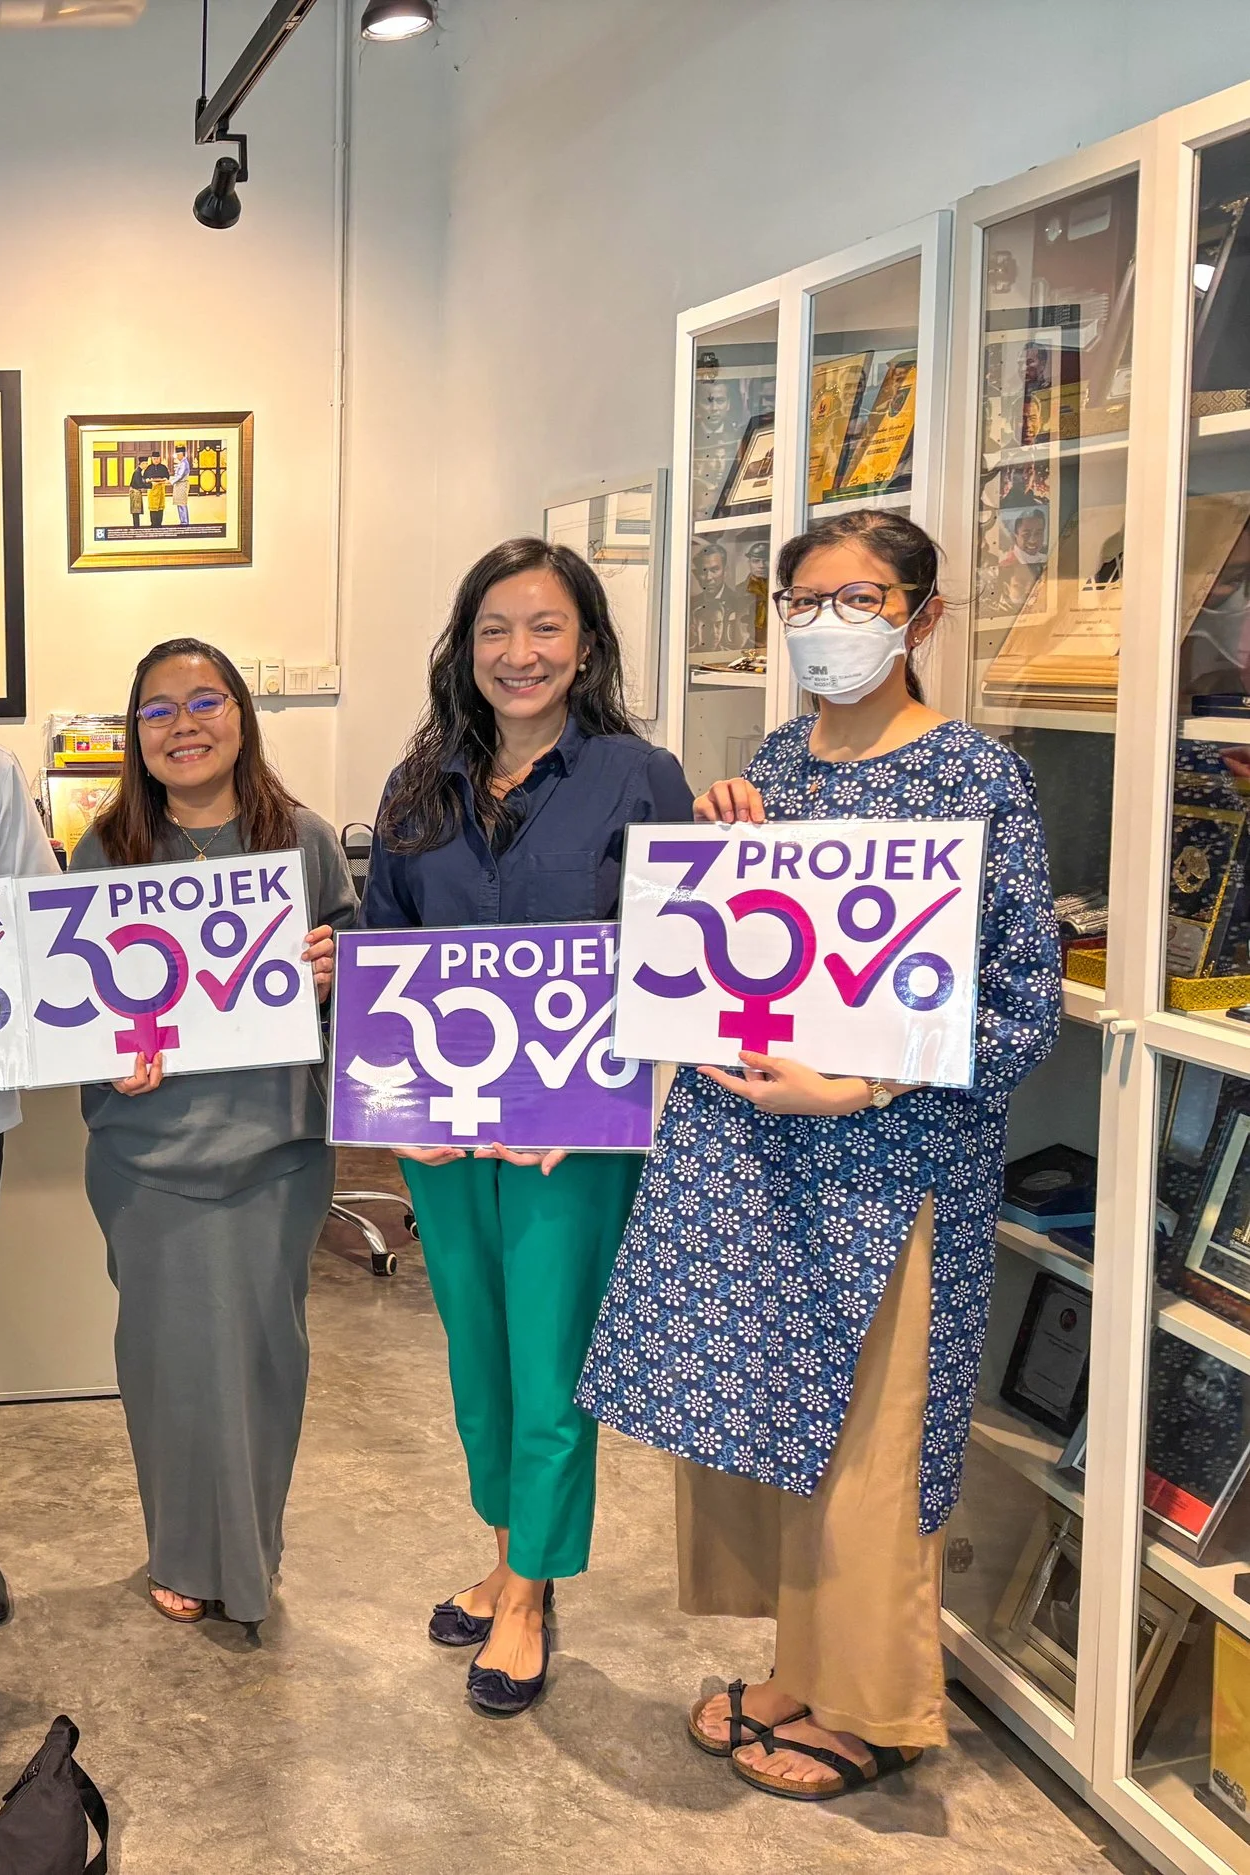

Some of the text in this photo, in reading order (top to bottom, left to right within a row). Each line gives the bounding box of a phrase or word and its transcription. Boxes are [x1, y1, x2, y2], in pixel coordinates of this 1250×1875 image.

[808, 665, 828, 675] 3M
[735, 838, 965, 881] PROJEK
[108, 866, 295, 917] PROJEK
